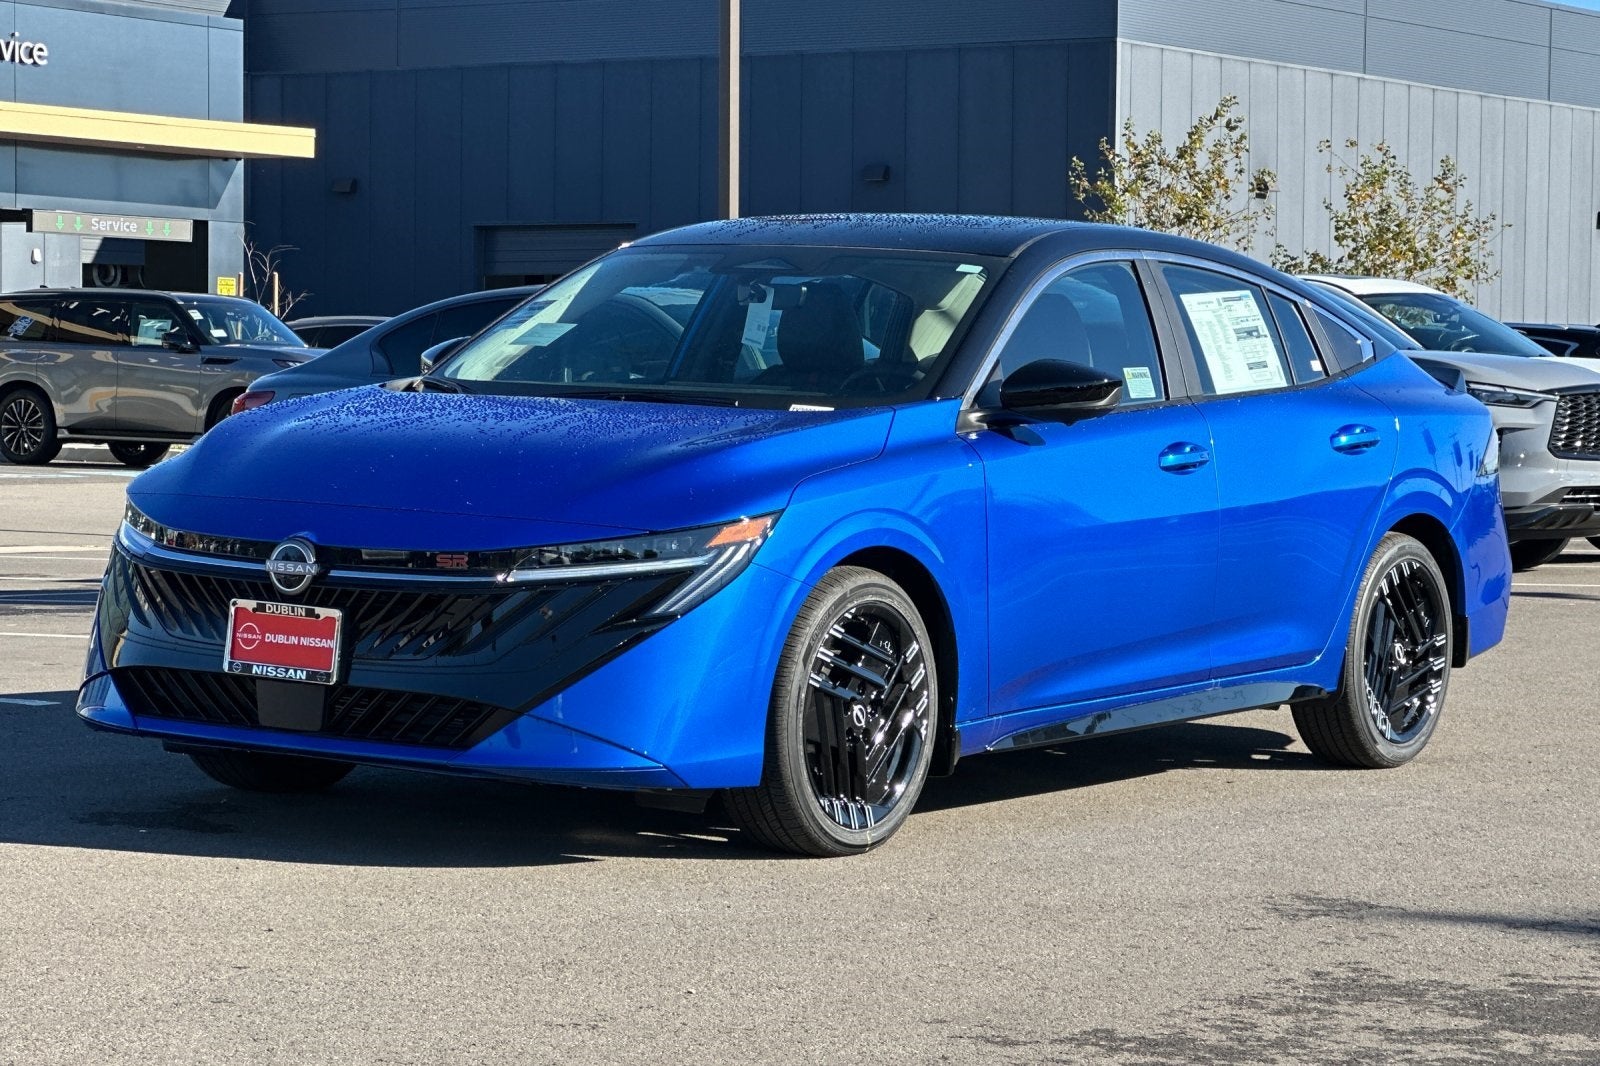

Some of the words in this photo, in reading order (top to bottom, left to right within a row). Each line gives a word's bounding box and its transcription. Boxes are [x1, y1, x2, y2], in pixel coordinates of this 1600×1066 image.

[91, 217, 138, 233] Service
[266, 561, 316, 574] NISSAN
[436, 554, 469, 568] SR
[265, 603, 306, 617] DUBLIN
[236, 632, 262, 640] NISSAN
[265, 633, 299, 645] DUBLIN
[300, 638, 335, 649] NISSAN
[251, 664, 307, 680] NISSAN
